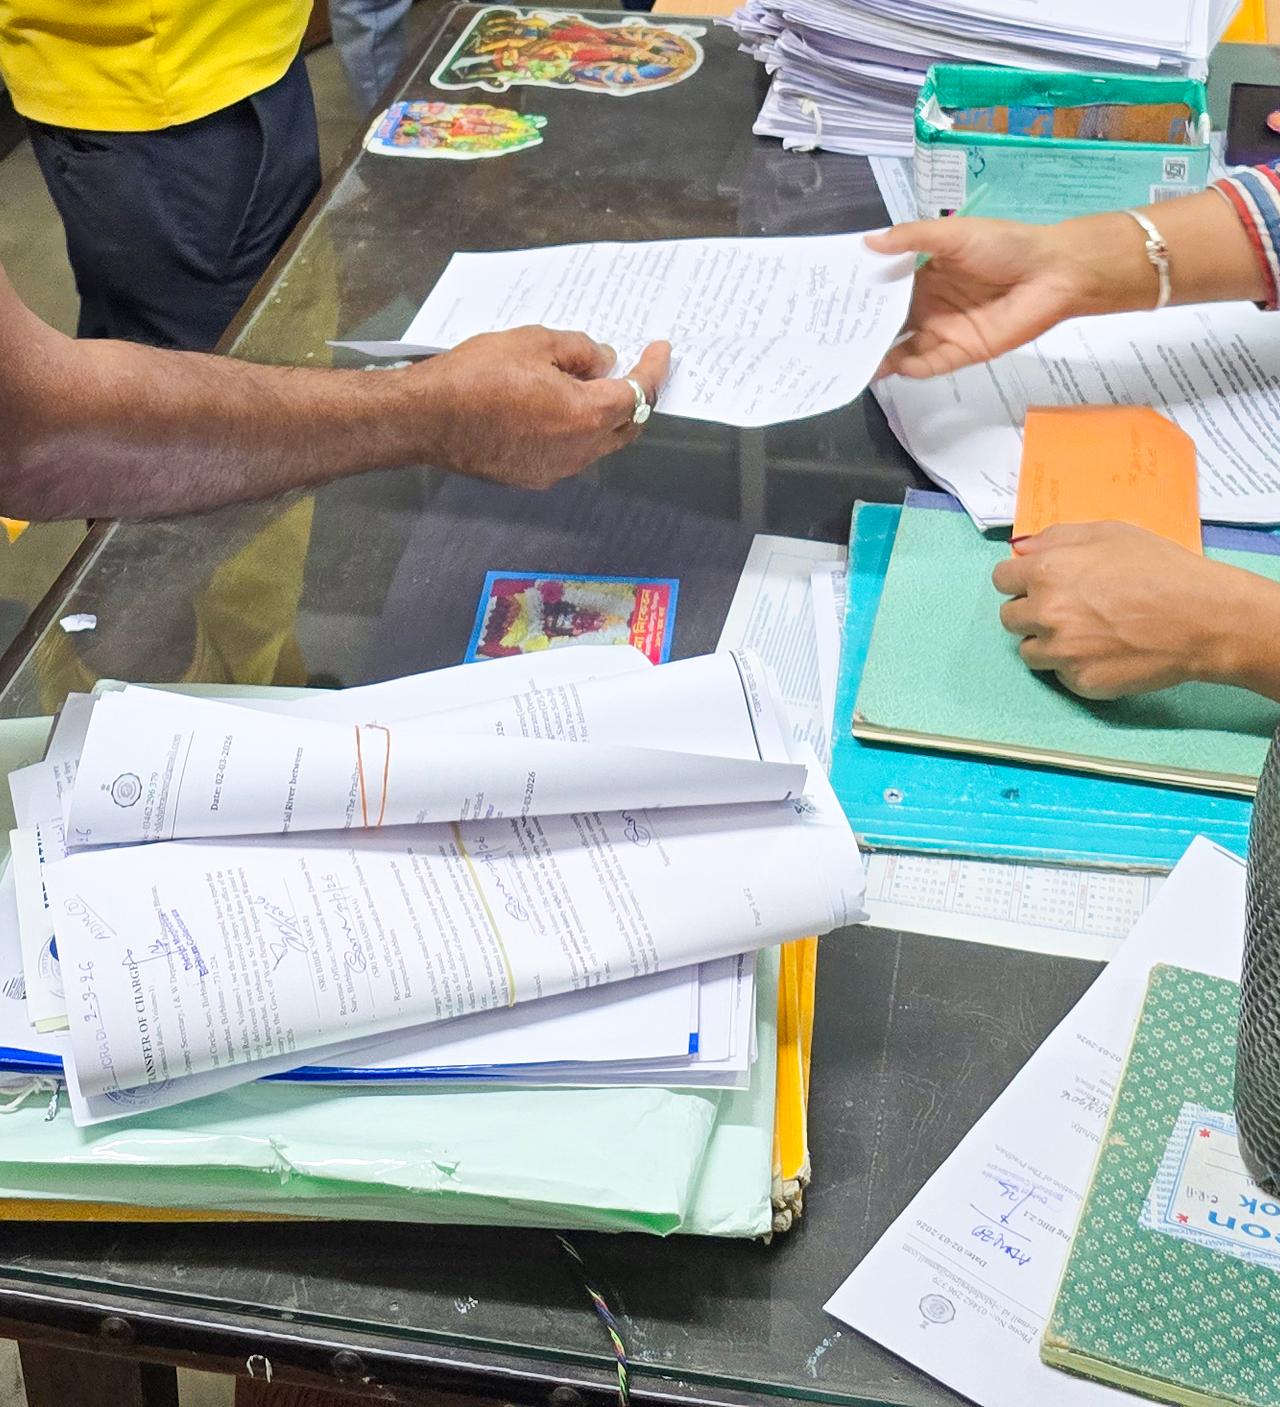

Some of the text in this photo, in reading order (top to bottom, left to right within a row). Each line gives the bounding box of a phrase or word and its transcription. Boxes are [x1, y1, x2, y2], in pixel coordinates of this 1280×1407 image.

[210, 733, 233, 811] Date: 02-03-2026
[288, 746, 303, 784] between
[284, 785, 296, 810] River
[262, 959, 270, 977] West
[129, 962, 145, 1013] CHARGE
[137, 1014, 149, 1033] OF
[914, 1218, 987, 1267] Date: 02-03-2026
[931, 1276, 947, 1289] 379
[963, 1295, 988, 1315] 03462
[1001, 1319, 1032, 1343] Phone
[1011, 1313, 1038, 1334] E-mail
